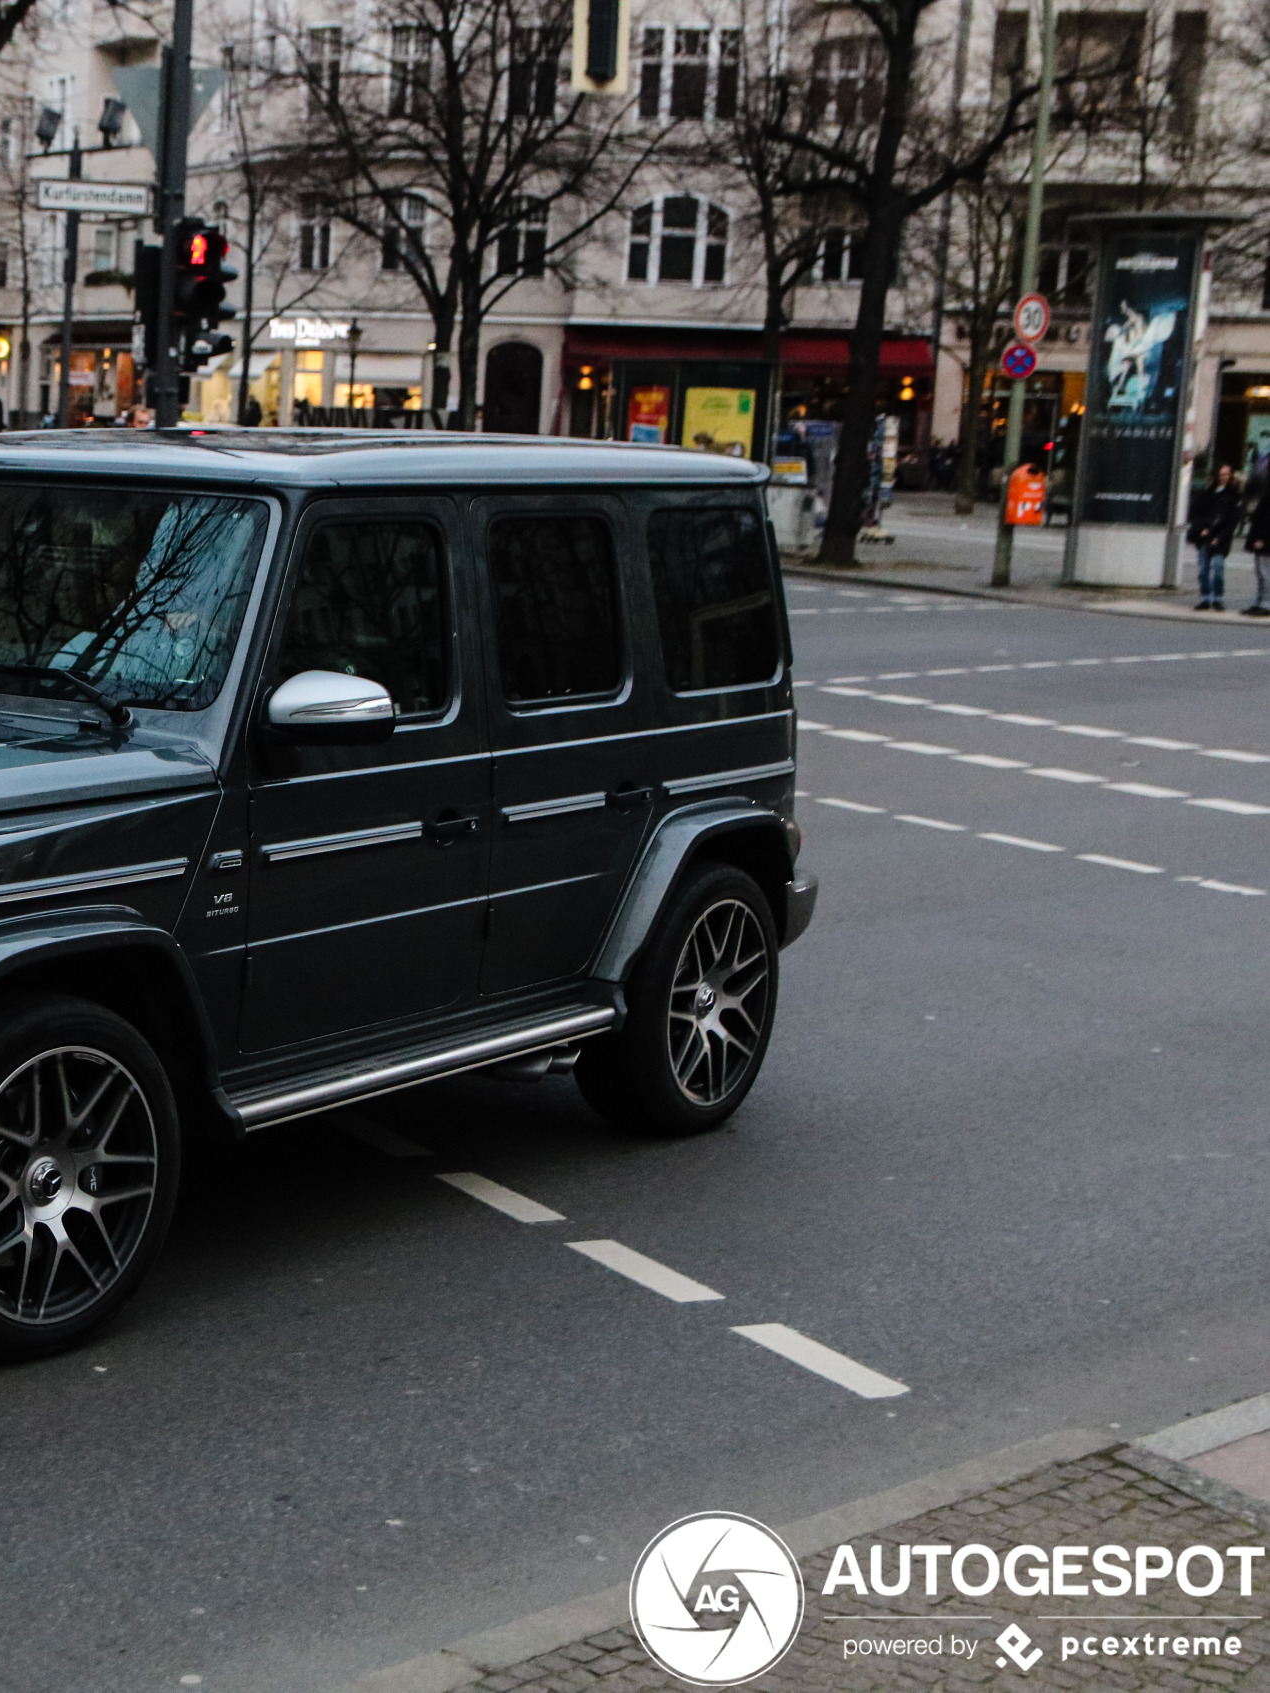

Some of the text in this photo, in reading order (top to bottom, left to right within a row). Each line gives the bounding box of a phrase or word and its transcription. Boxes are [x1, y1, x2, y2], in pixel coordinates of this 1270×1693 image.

[42, 184, 144, 205] Kurfürstendamm
[1022, 307, 1043, 330] 30
[213, 892, 234, 905] V8
[205, 905, 240, 918] BITURBO
